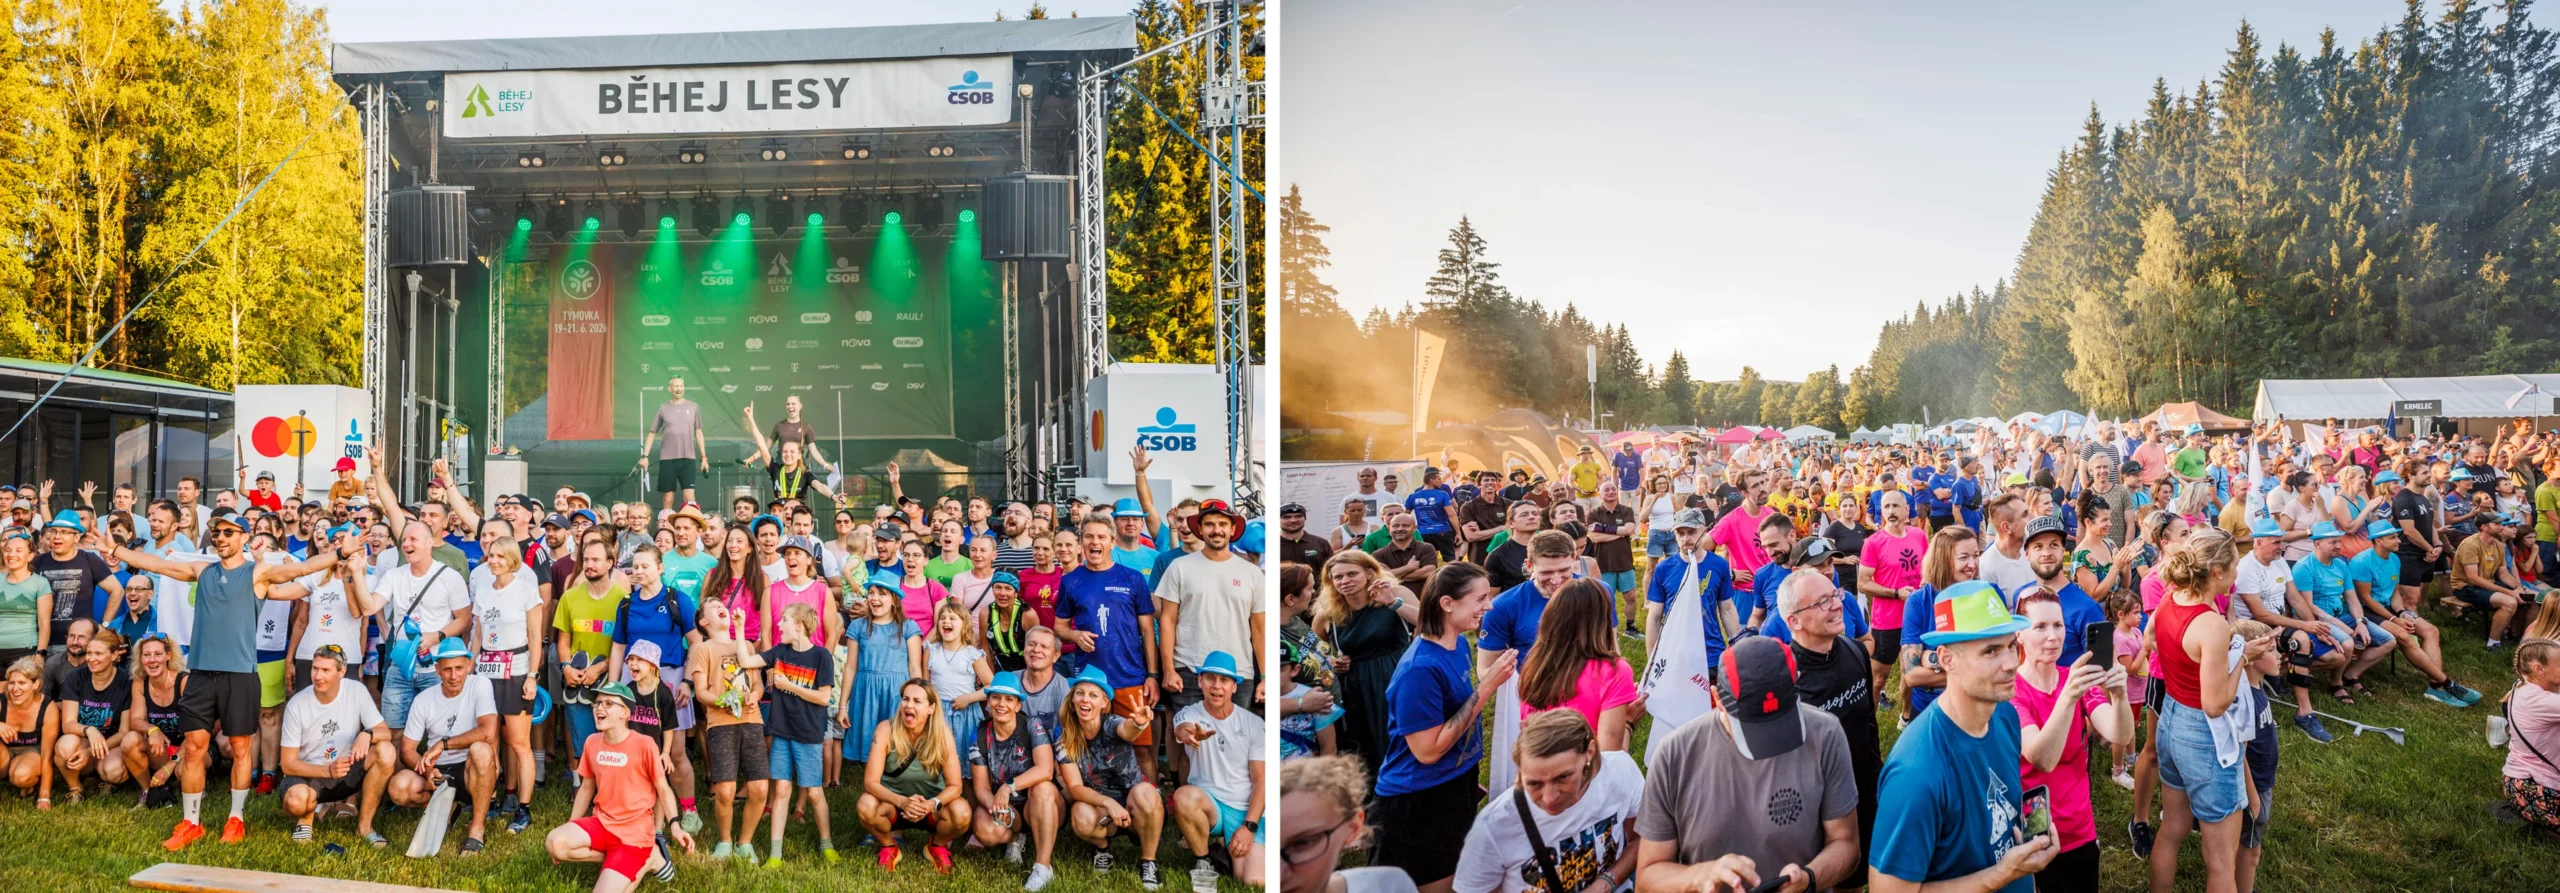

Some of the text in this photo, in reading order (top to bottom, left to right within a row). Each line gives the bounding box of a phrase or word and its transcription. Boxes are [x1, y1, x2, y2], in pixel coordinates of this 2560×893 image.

[498, 88, 533, 100] BĚHEJ
[598, 75, 851, 114] BĚHEJ LESY
[947, 91, 994, 105] ČSOB
[498, 102, 525, 112] LESY
[701, 274, 734, 286] ČSOB
[768, 276, 793, 285] BĚHEJ
[825, 272, 860, 283] ČSOB
[563, 308, 600, 321] TÝMOVKA
[749, 315, 778, 323] nova
[896, 312, 924, 321] RAUL!
[589, 323, 608, 333] 2026
[695, 341, 724, 350] nova
[841, 338, 871, 347] nova
[1136, 433, 1197, 451] ČSOB
[344, 442, 363, 459] ČSOB
[478, 663, 501, 673] 80301
